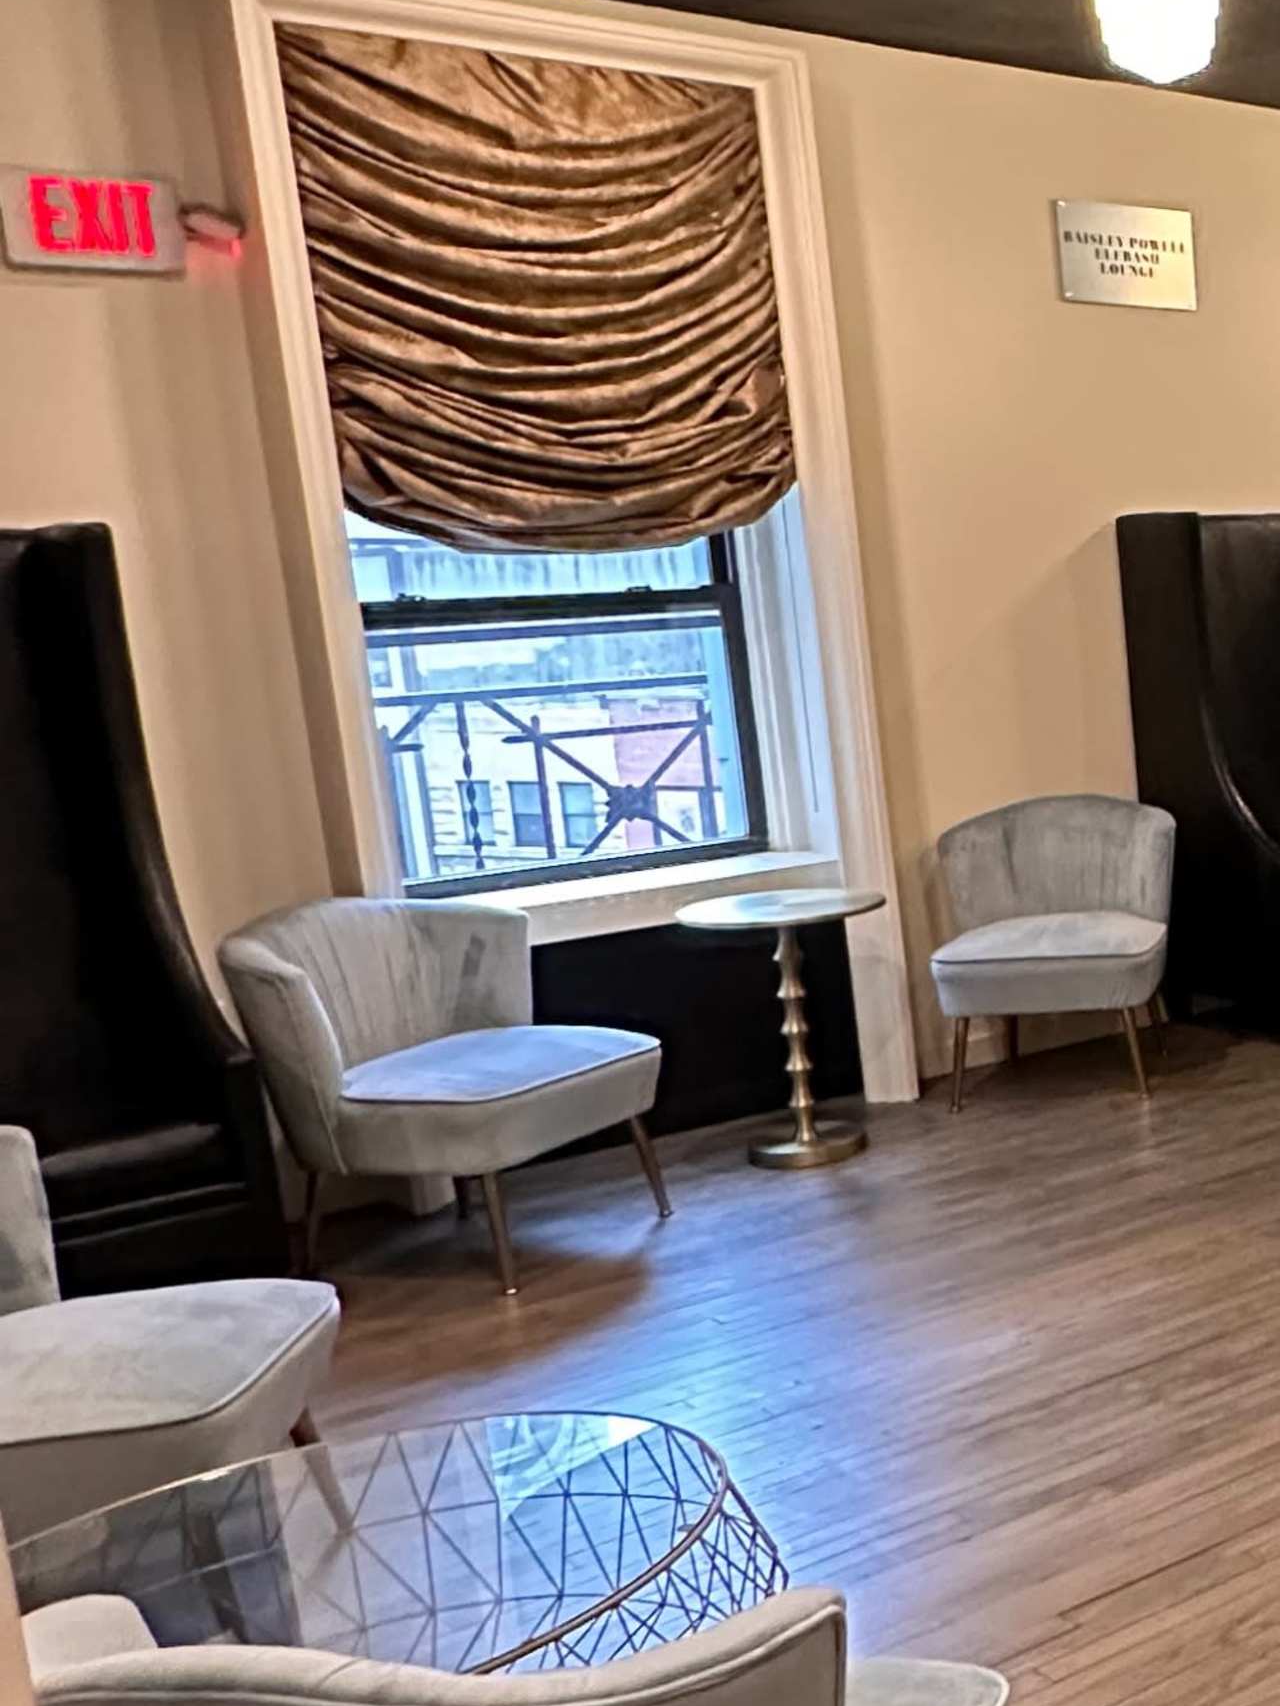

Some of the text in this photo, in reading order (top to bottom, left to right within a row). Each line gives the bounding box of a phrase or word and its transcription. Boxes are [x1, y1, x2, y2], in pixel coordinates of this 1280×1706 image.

[28, 175, 157, 257] EXIT
[1129, 237, 1185, 253] POWELL
[1099, 262, 1154, 278] LOUNGE
